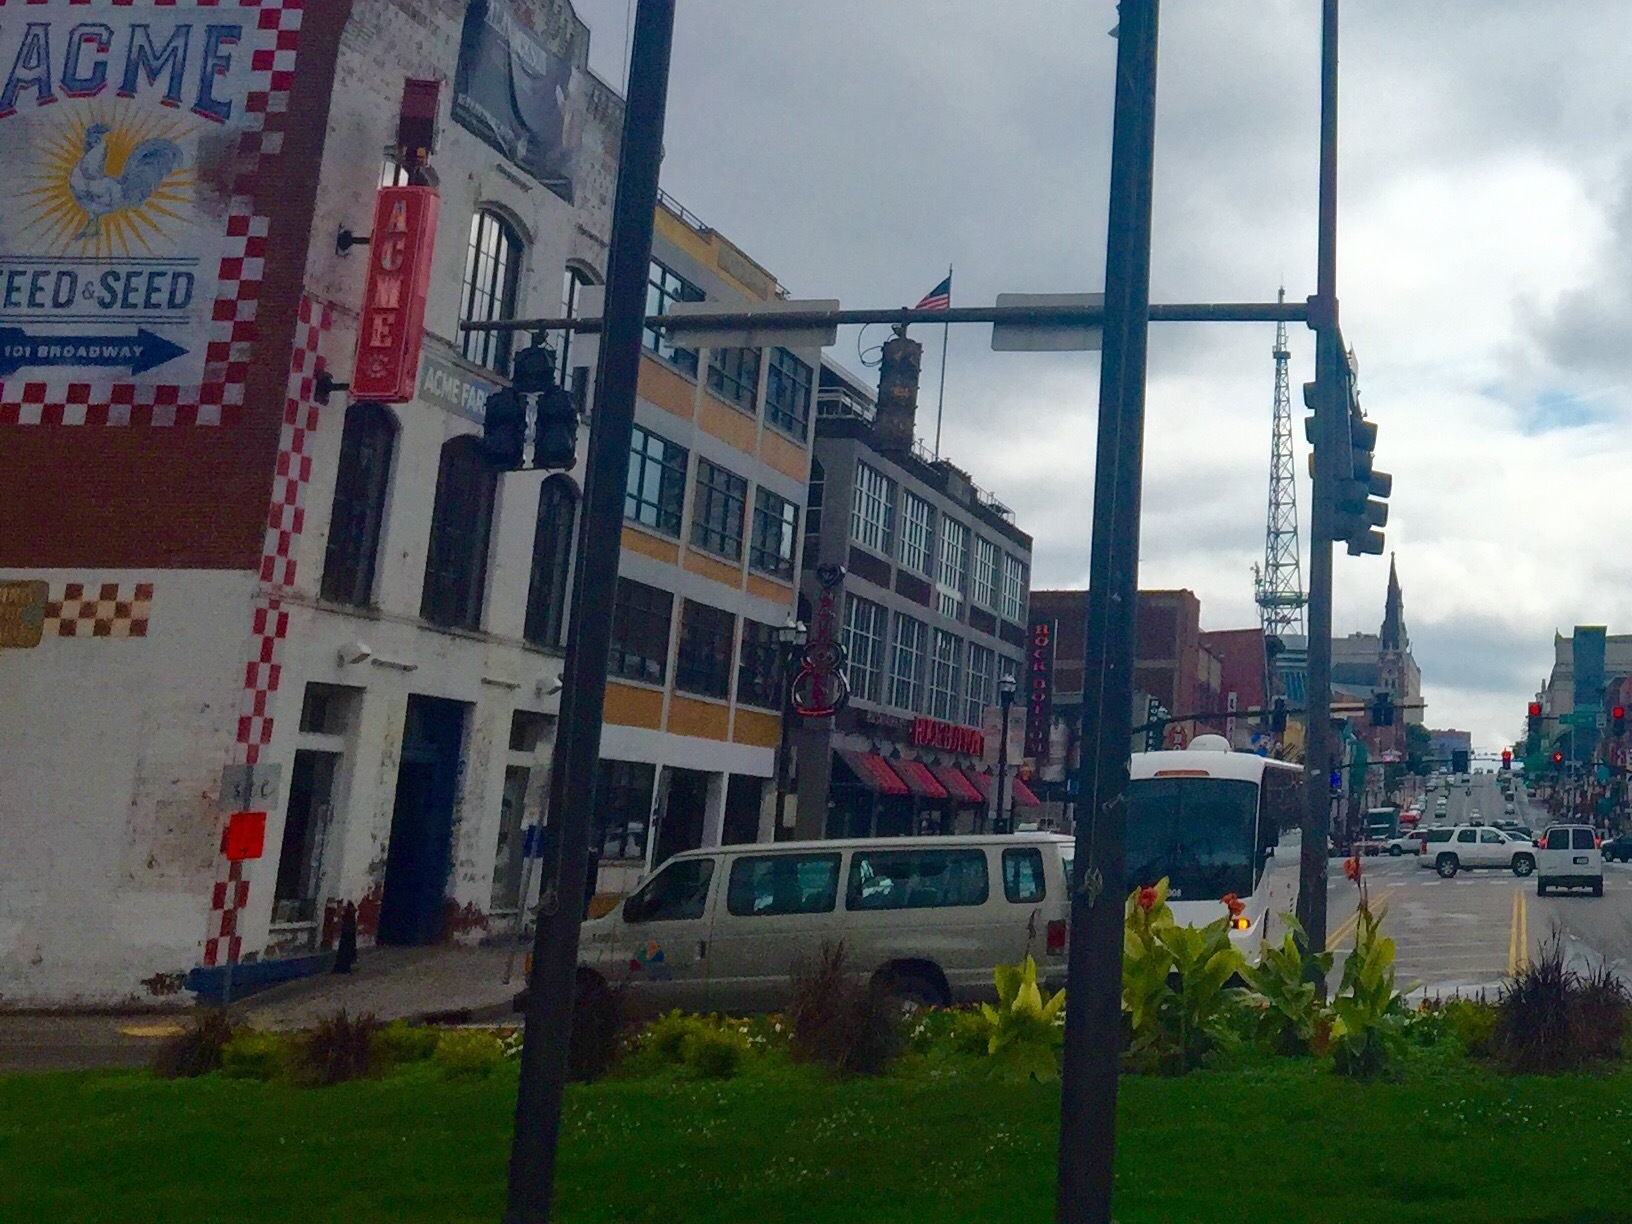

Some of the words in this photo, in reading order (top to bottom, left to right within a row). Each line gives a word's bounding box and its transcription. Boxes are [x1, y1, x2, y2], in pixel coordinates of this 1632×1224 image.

[0, 22, 243, 124] ACME
[82, 280, 96, 300] &
[97, 270, 195, 309] SEED
[369, 199, 408, 348] ACME
[4, 345, 32, 358] 101
[37, 344, 144, 359] BROADWAY
[424, 366, 462, 405] ACME
